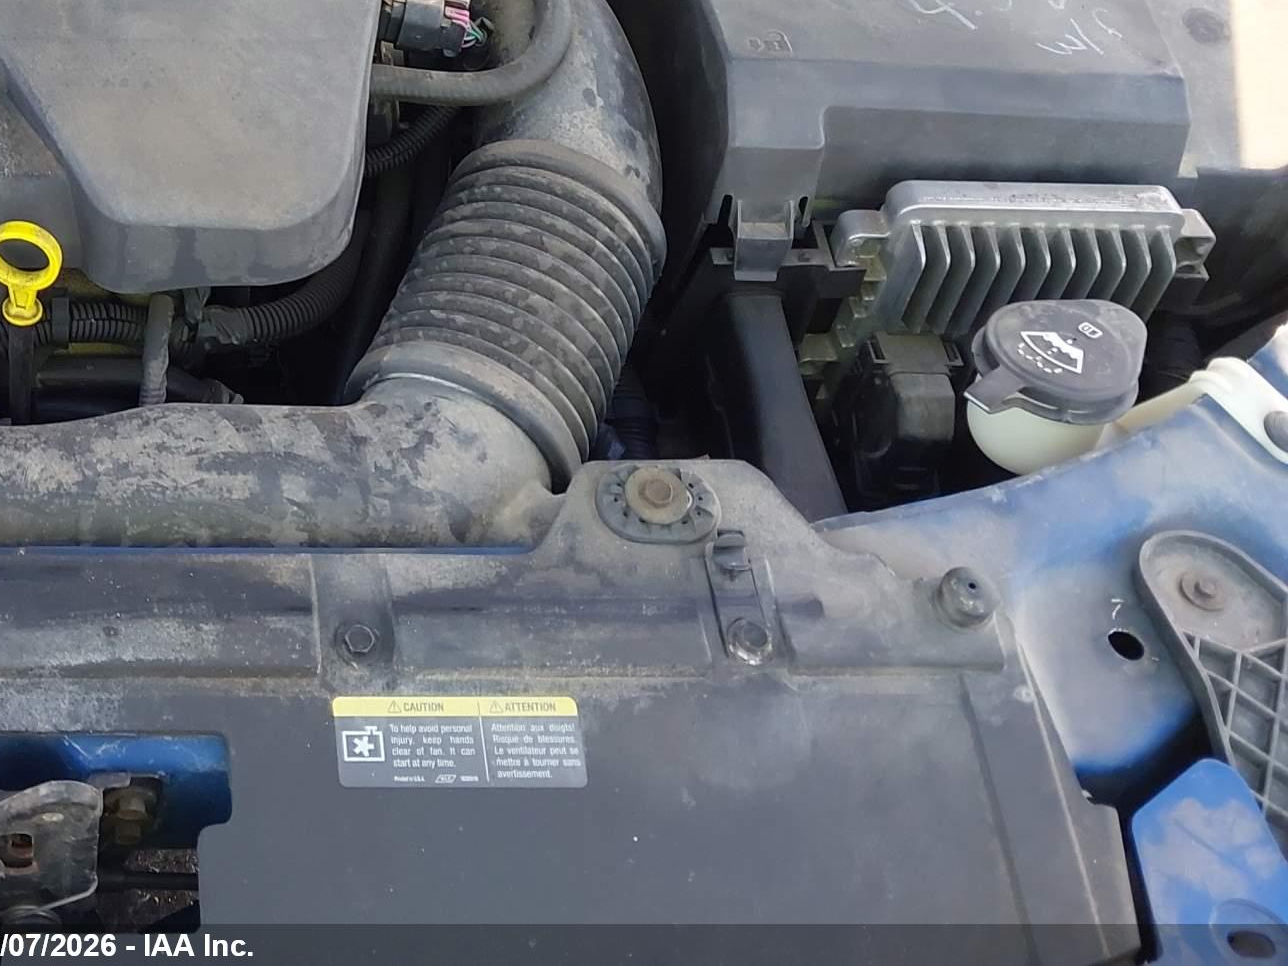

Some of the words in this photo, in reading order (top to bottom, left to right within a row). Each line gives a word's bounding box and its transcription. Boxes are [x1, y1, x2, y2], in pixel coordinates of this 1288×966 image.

[403, 702, 444, 712] CAUTION
[505, 703, 556, 712] ATTENTION
[389, 724, 398, 733] To
[401, 724, 416, 734] help
[419, 724, 438, 733] avoid
[441, 724, 472, 734] personal
[491, 723, 525, 732] Attention
[423, 736, 442, 745] keep
[450, 736, 474, 744] hands
[492, 735, 519, 745] Risque
[523, 735, 533, 743] de
[392, 747, 410, 755] clear
[416, 747, 424, 755] of
[494, 746, 503, 755] Le
[508, 746, 546, 754] ventilateur
[550, 747, 566, 756] peut
[393, 759, 410, 767] start
[412, 759, 420, 767] at
[422, 761, 435, 769] any
[437, 759, 456, 767] time.
[496, 758, 520, 766] mettre
[532, 758, 559, 766] tourner
[498, 770, 553, 778] avertissement.
